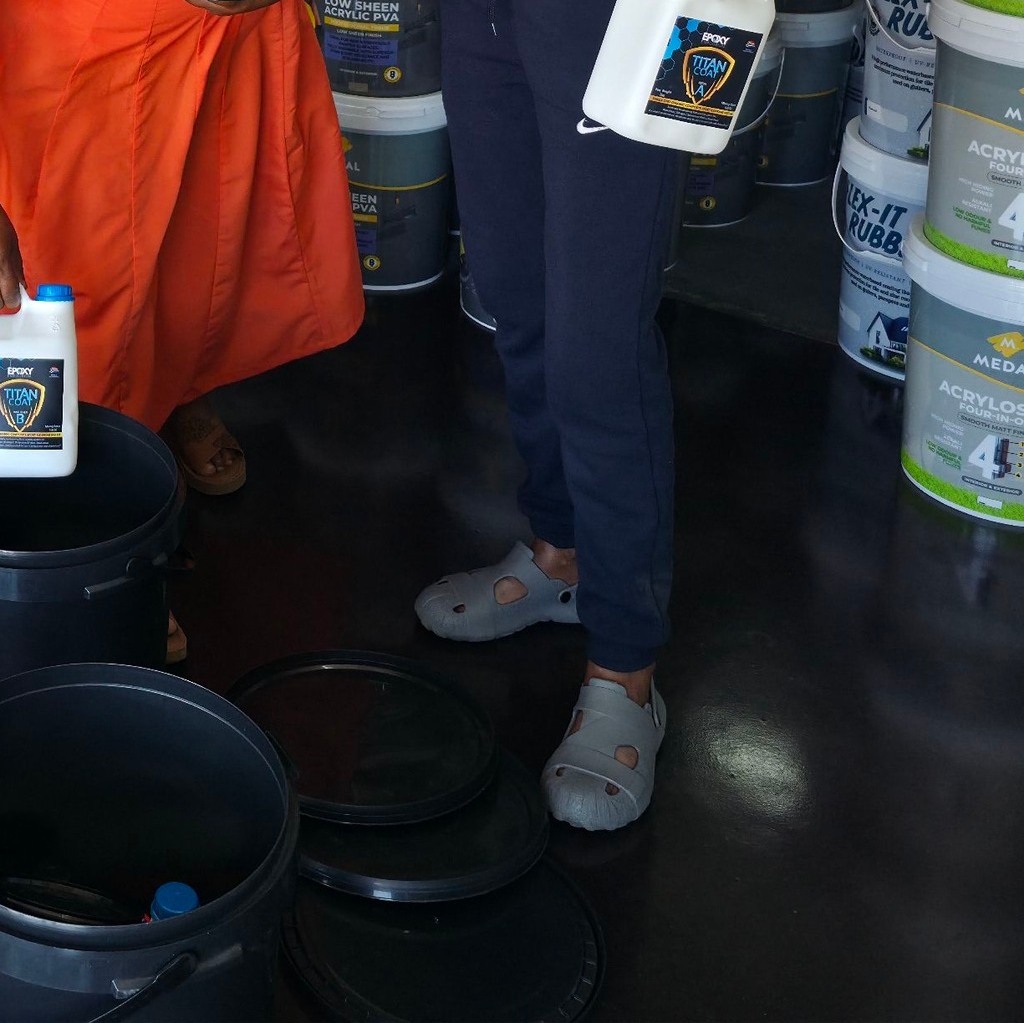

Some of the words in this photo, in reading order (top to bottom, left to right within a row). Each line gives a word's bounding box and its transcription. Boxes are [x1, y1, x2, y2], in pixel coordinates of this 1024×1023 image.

[324, 5, 370, 21] ACRYLIC
[373, 13, 400, 22] PVA
[355, 1, 400, 13] SHEEN
[887, 6, 934, 40] RUB
[702, 32, 731, 45] EPOXY
[692, 54, 728, 74] TITAN
[693, 66, 721, 78] COAT
[695, 84, 705, 97] A
[967, 139, 1024, 165] ACRY
[990, 173, 1023, 187] SMOOTH
[352, 192, 377, 204] EEN
[352, 203, 378, 213] PVA
[847, 182, 908, 229] LEX-IT
[848, 213, 904, 258] RUBB
[7, 367, 34, 375] EPOXY
[4, 387, 38, 400] TITAN
[938, 379, 1024, 417] ACRYLOS
[8, 398, 33, 407] COAT
[16, 413, 25, 424] B
[959, 402, 1024, 425] FOUR-IN-O
[960, 415, 990, 429] SMOOTH
[991, 424, 1011, 433] MATT
